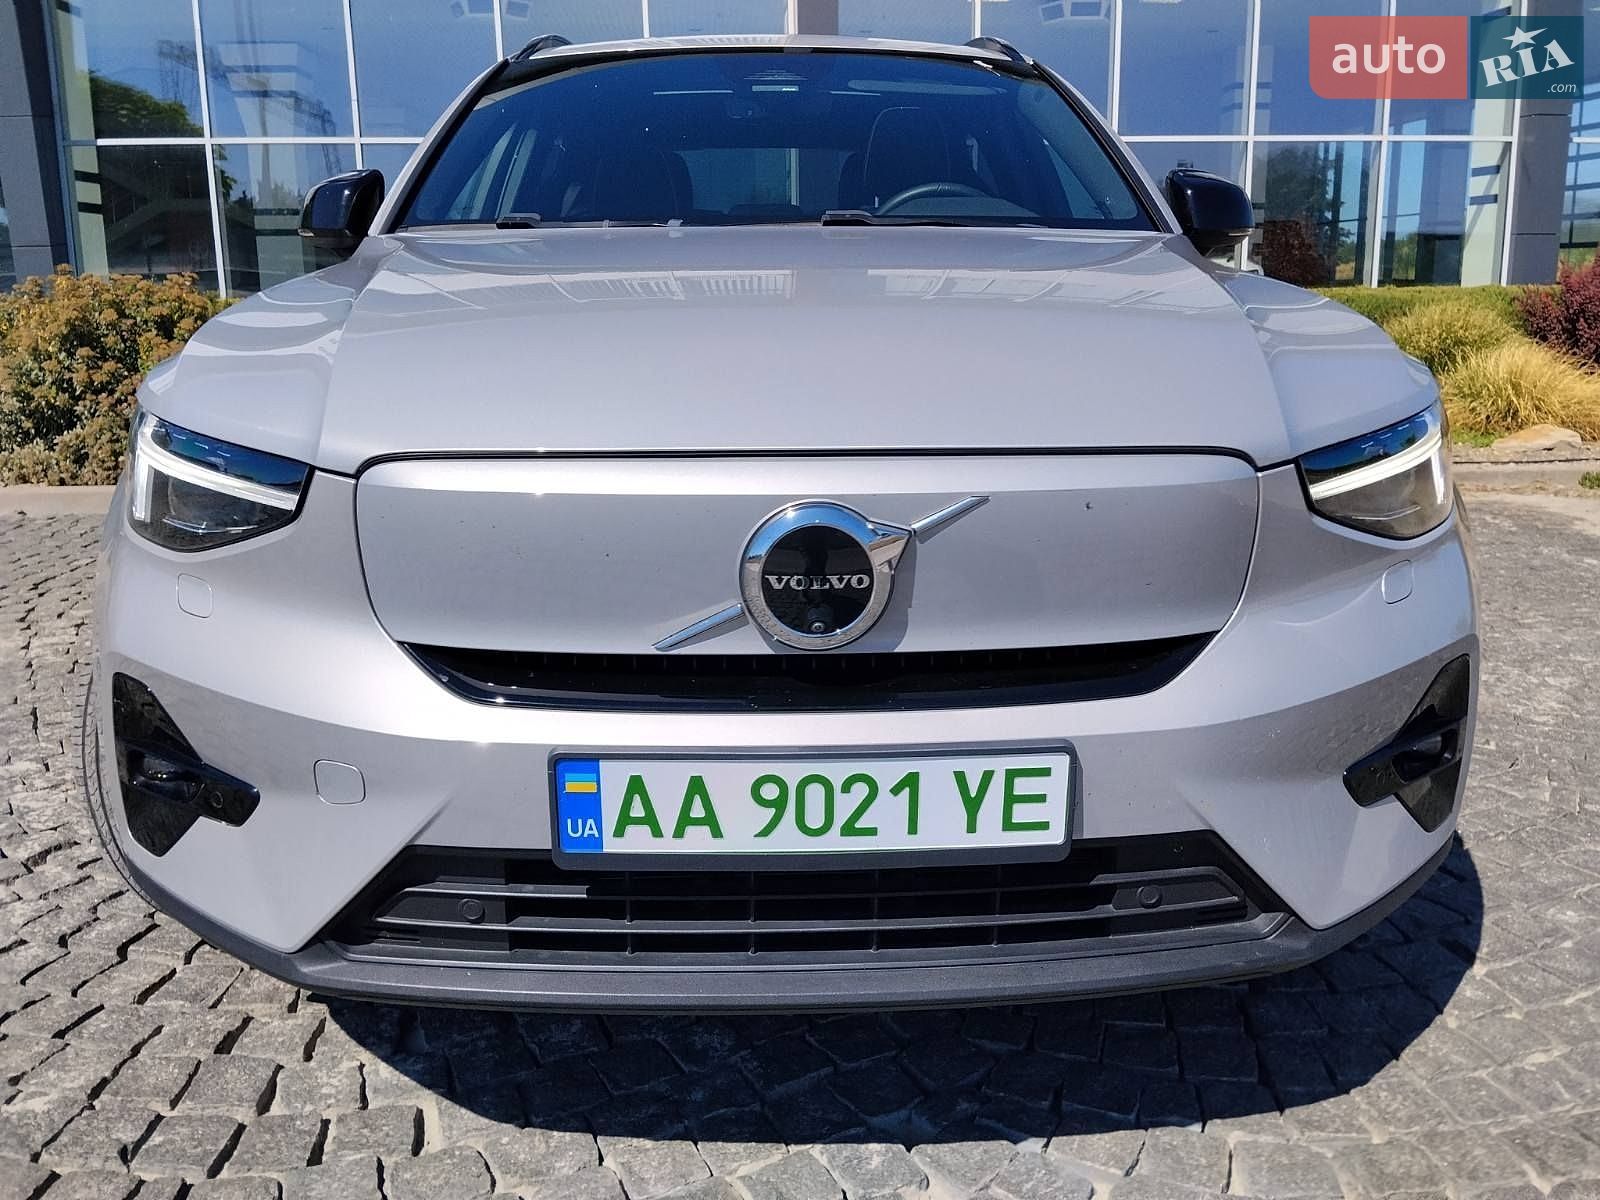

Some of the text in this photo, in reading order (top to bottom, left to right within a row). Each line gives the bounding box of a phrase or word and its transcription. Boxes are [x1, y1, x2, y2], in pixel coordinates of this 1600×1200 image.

[764, 574, 871, 591] VOLVO
[612, 767, 1052, 838] AA 9021 YE
[567, 818, 599, 838] UA
